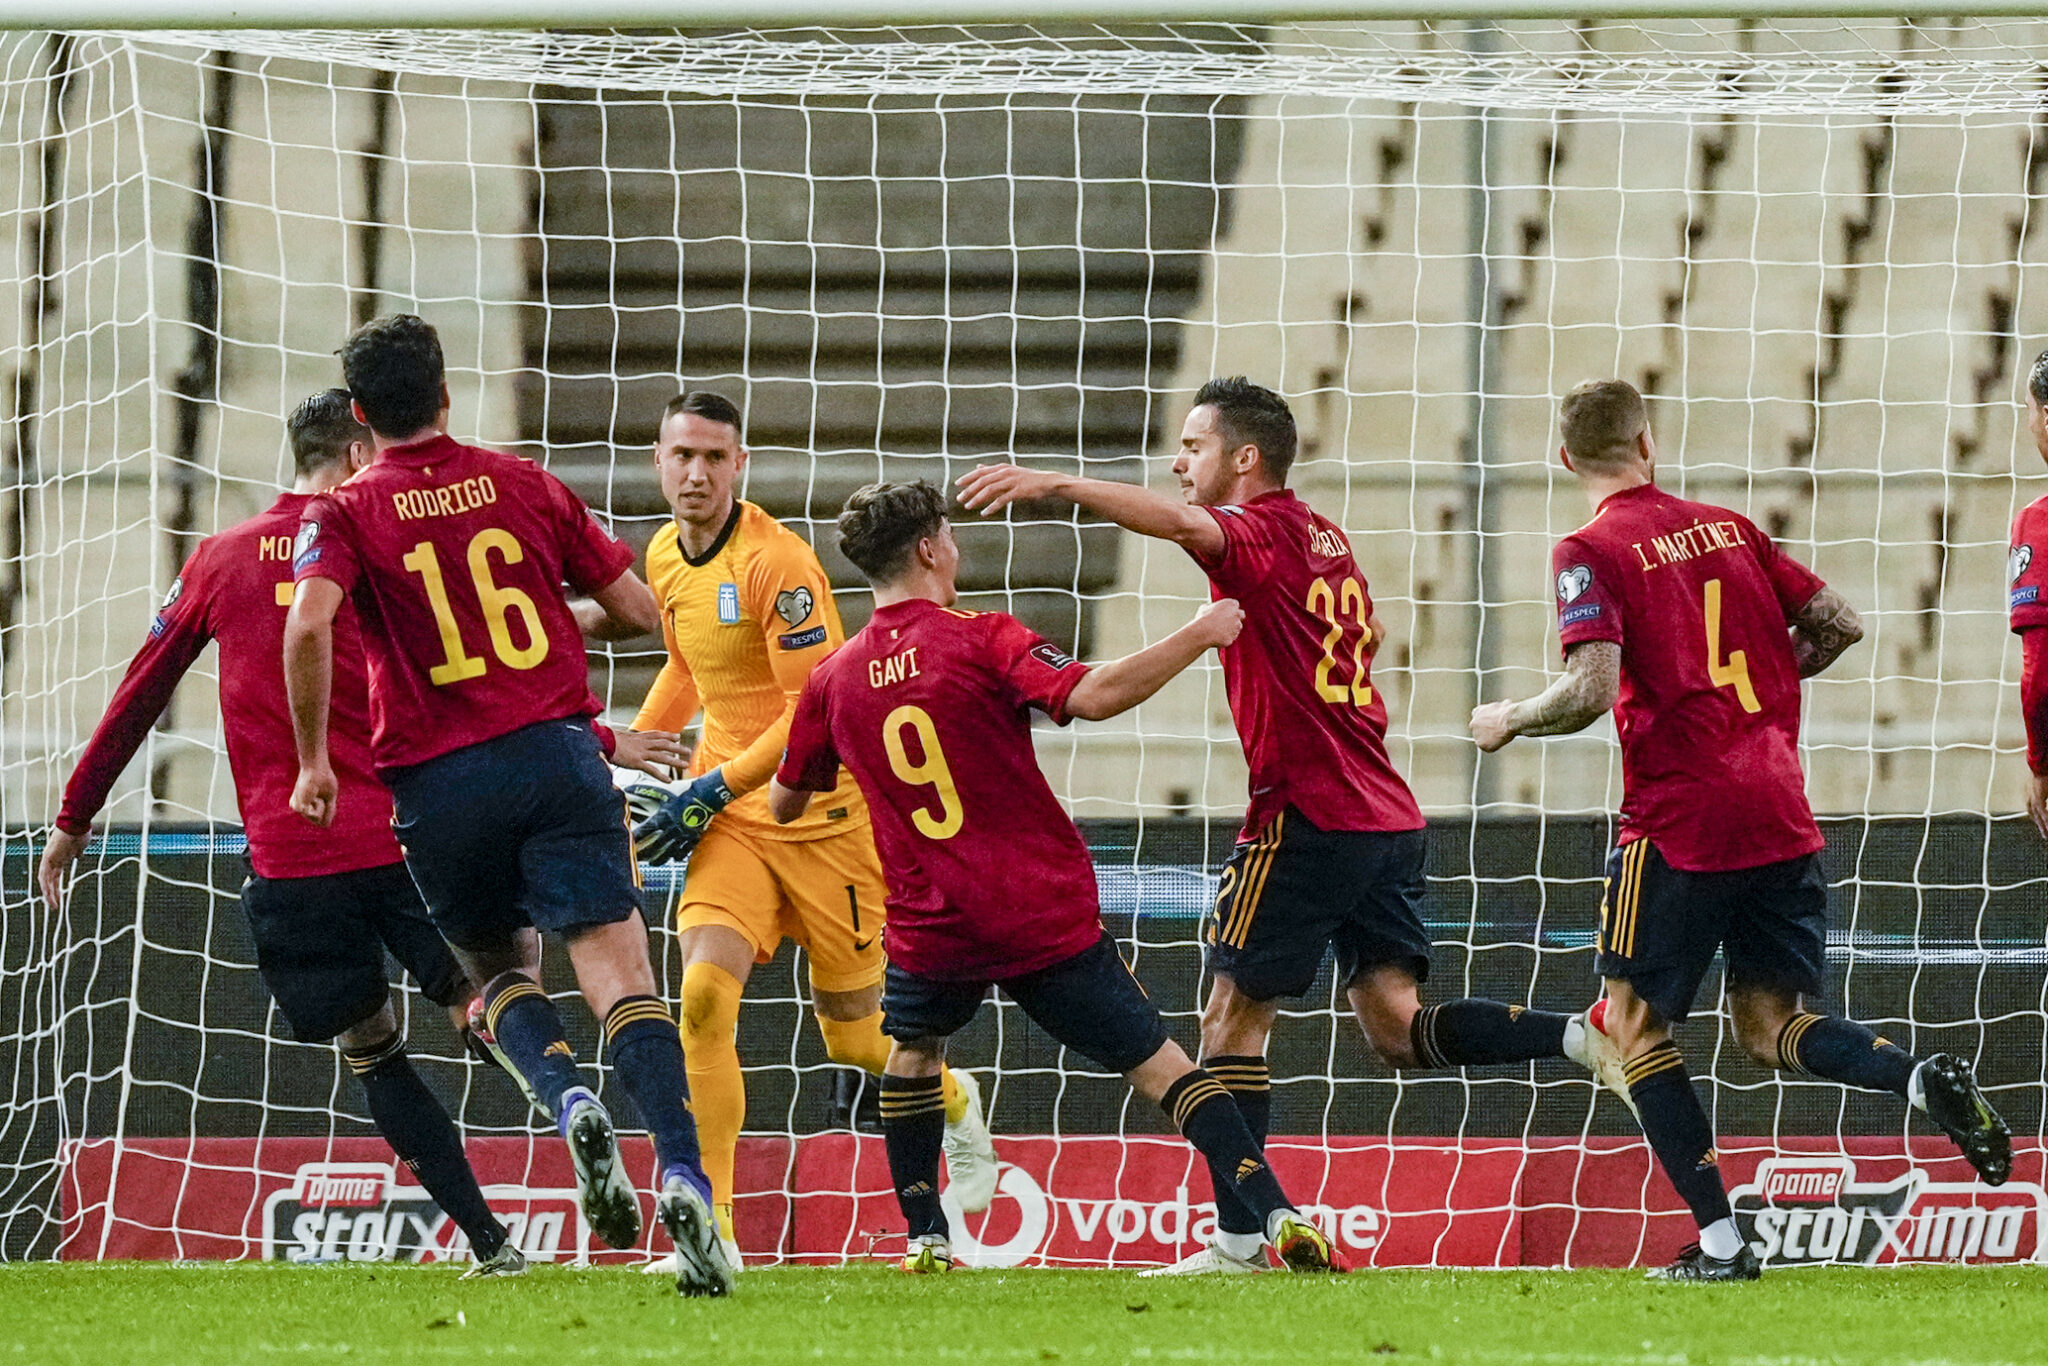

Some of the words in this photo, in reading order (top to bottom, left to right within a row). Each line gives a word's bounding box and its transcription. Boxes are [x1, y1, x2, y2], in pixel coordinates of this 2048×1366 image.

[392, 475, 497, 521] RODRIGO
[1632, 543, 1658, 572] I.
[1651, 518, 1747, 564] MARTÍNEZ
[404, 528, 549, 686] 16
[1564, 606, 1600, 620] RESPECT
[791, 629, 826, 646] RESPECT
[1306, 576, 1372, 706] 22
[1704, 579, 1761, 713] 4
[868, 647, 921, 689] GAVI
[882, 705, 964, 840] 9
[844, 884, 860, 933] 1
[1769, 1171, 1838, 1196] pame
[1066, 1186, 1380, 1250] vodane
